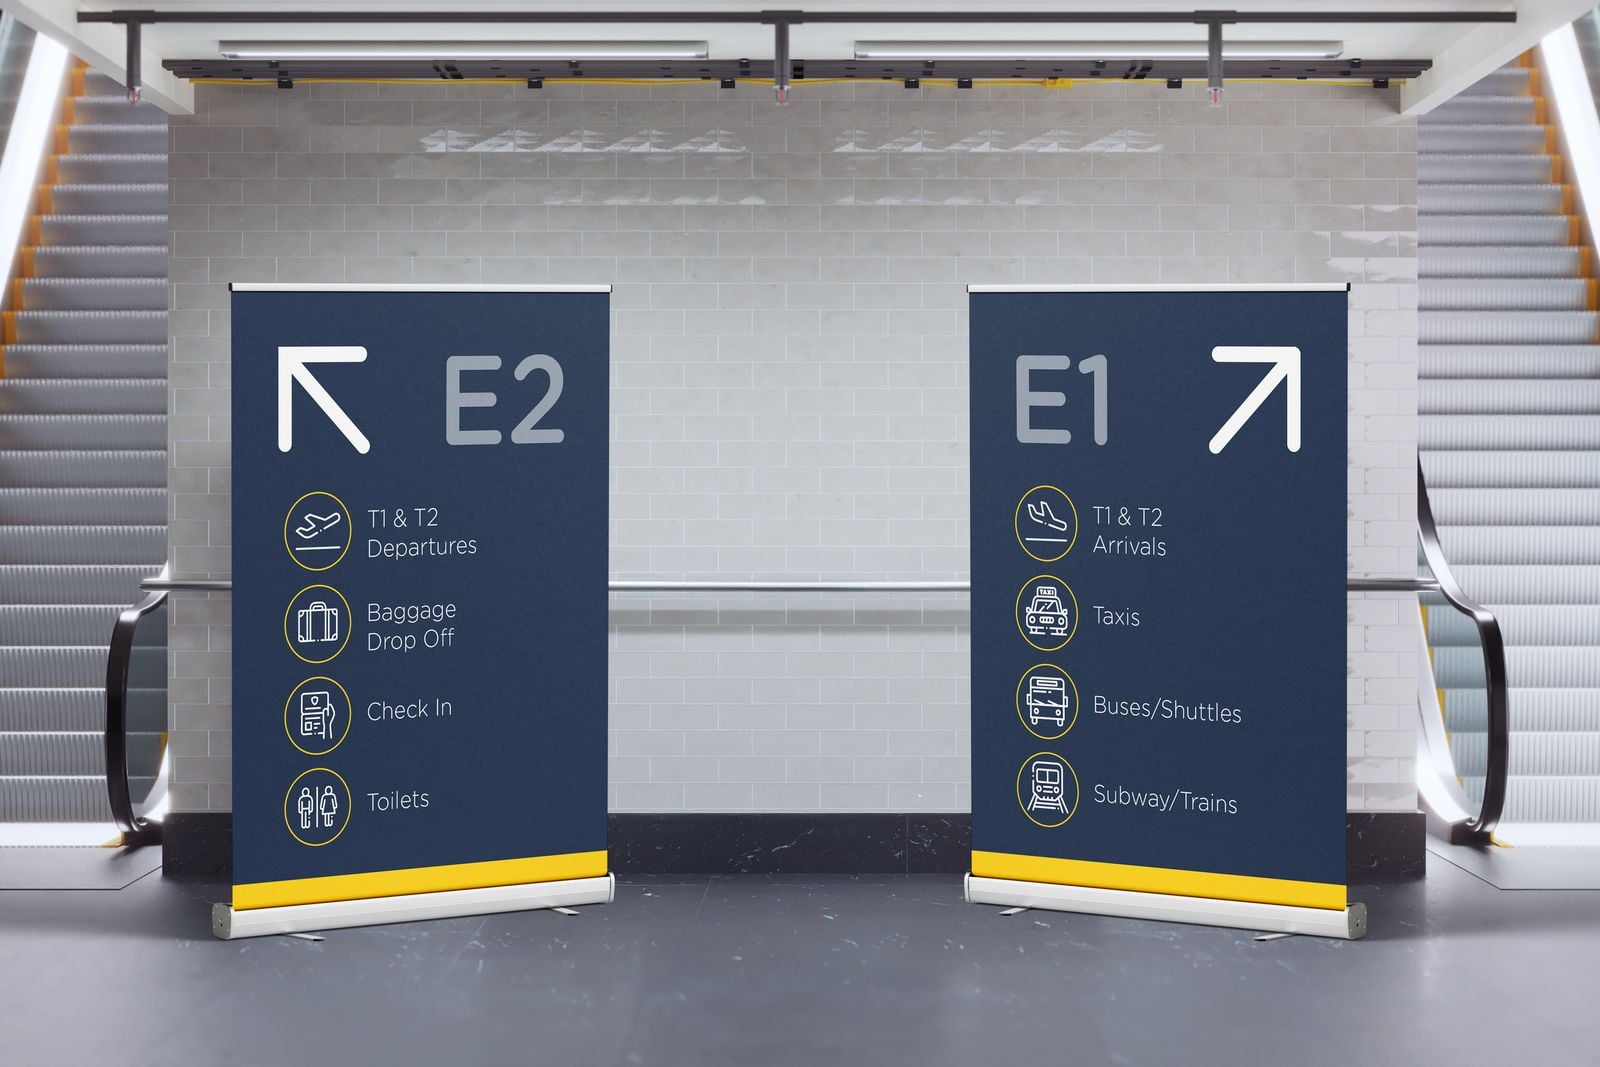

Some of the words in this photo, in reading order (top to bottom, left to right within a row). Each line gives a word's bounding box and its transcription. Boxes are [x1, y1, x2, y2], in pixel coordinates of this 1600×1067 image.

[446, 354, 564, 445] E2
[1016, 355, 1107, 445] E1
[368, 509, 386, 528] T1
[394, 508, 408, 527] &
[414, 508, 438, 527] T2
[1092, 506, 1110, 525] T1
[1118, 507, 1132, 526] &
[1138, 507, 1163, 527] T2
[368, 537, 477, 560] Departures
[1092, 535, 1167, 556] Arrivals
[1039, 588, 1055, 596] TAXI
[368, 602, 457, 625] Baggage
[1093, 606, 1140, 626] Taxis
[368, 632, 417, 653] Drop
[424, 628, 455, 648] Off
[367, 699, 429, 721] Check
[436, 698, 452, 717] In
[1094, 695, 1242, 724] Buses/Shuttles
[367, 790, 429, 812] Toilets
[1094, 784, 1238, 814] Subway/Trains
